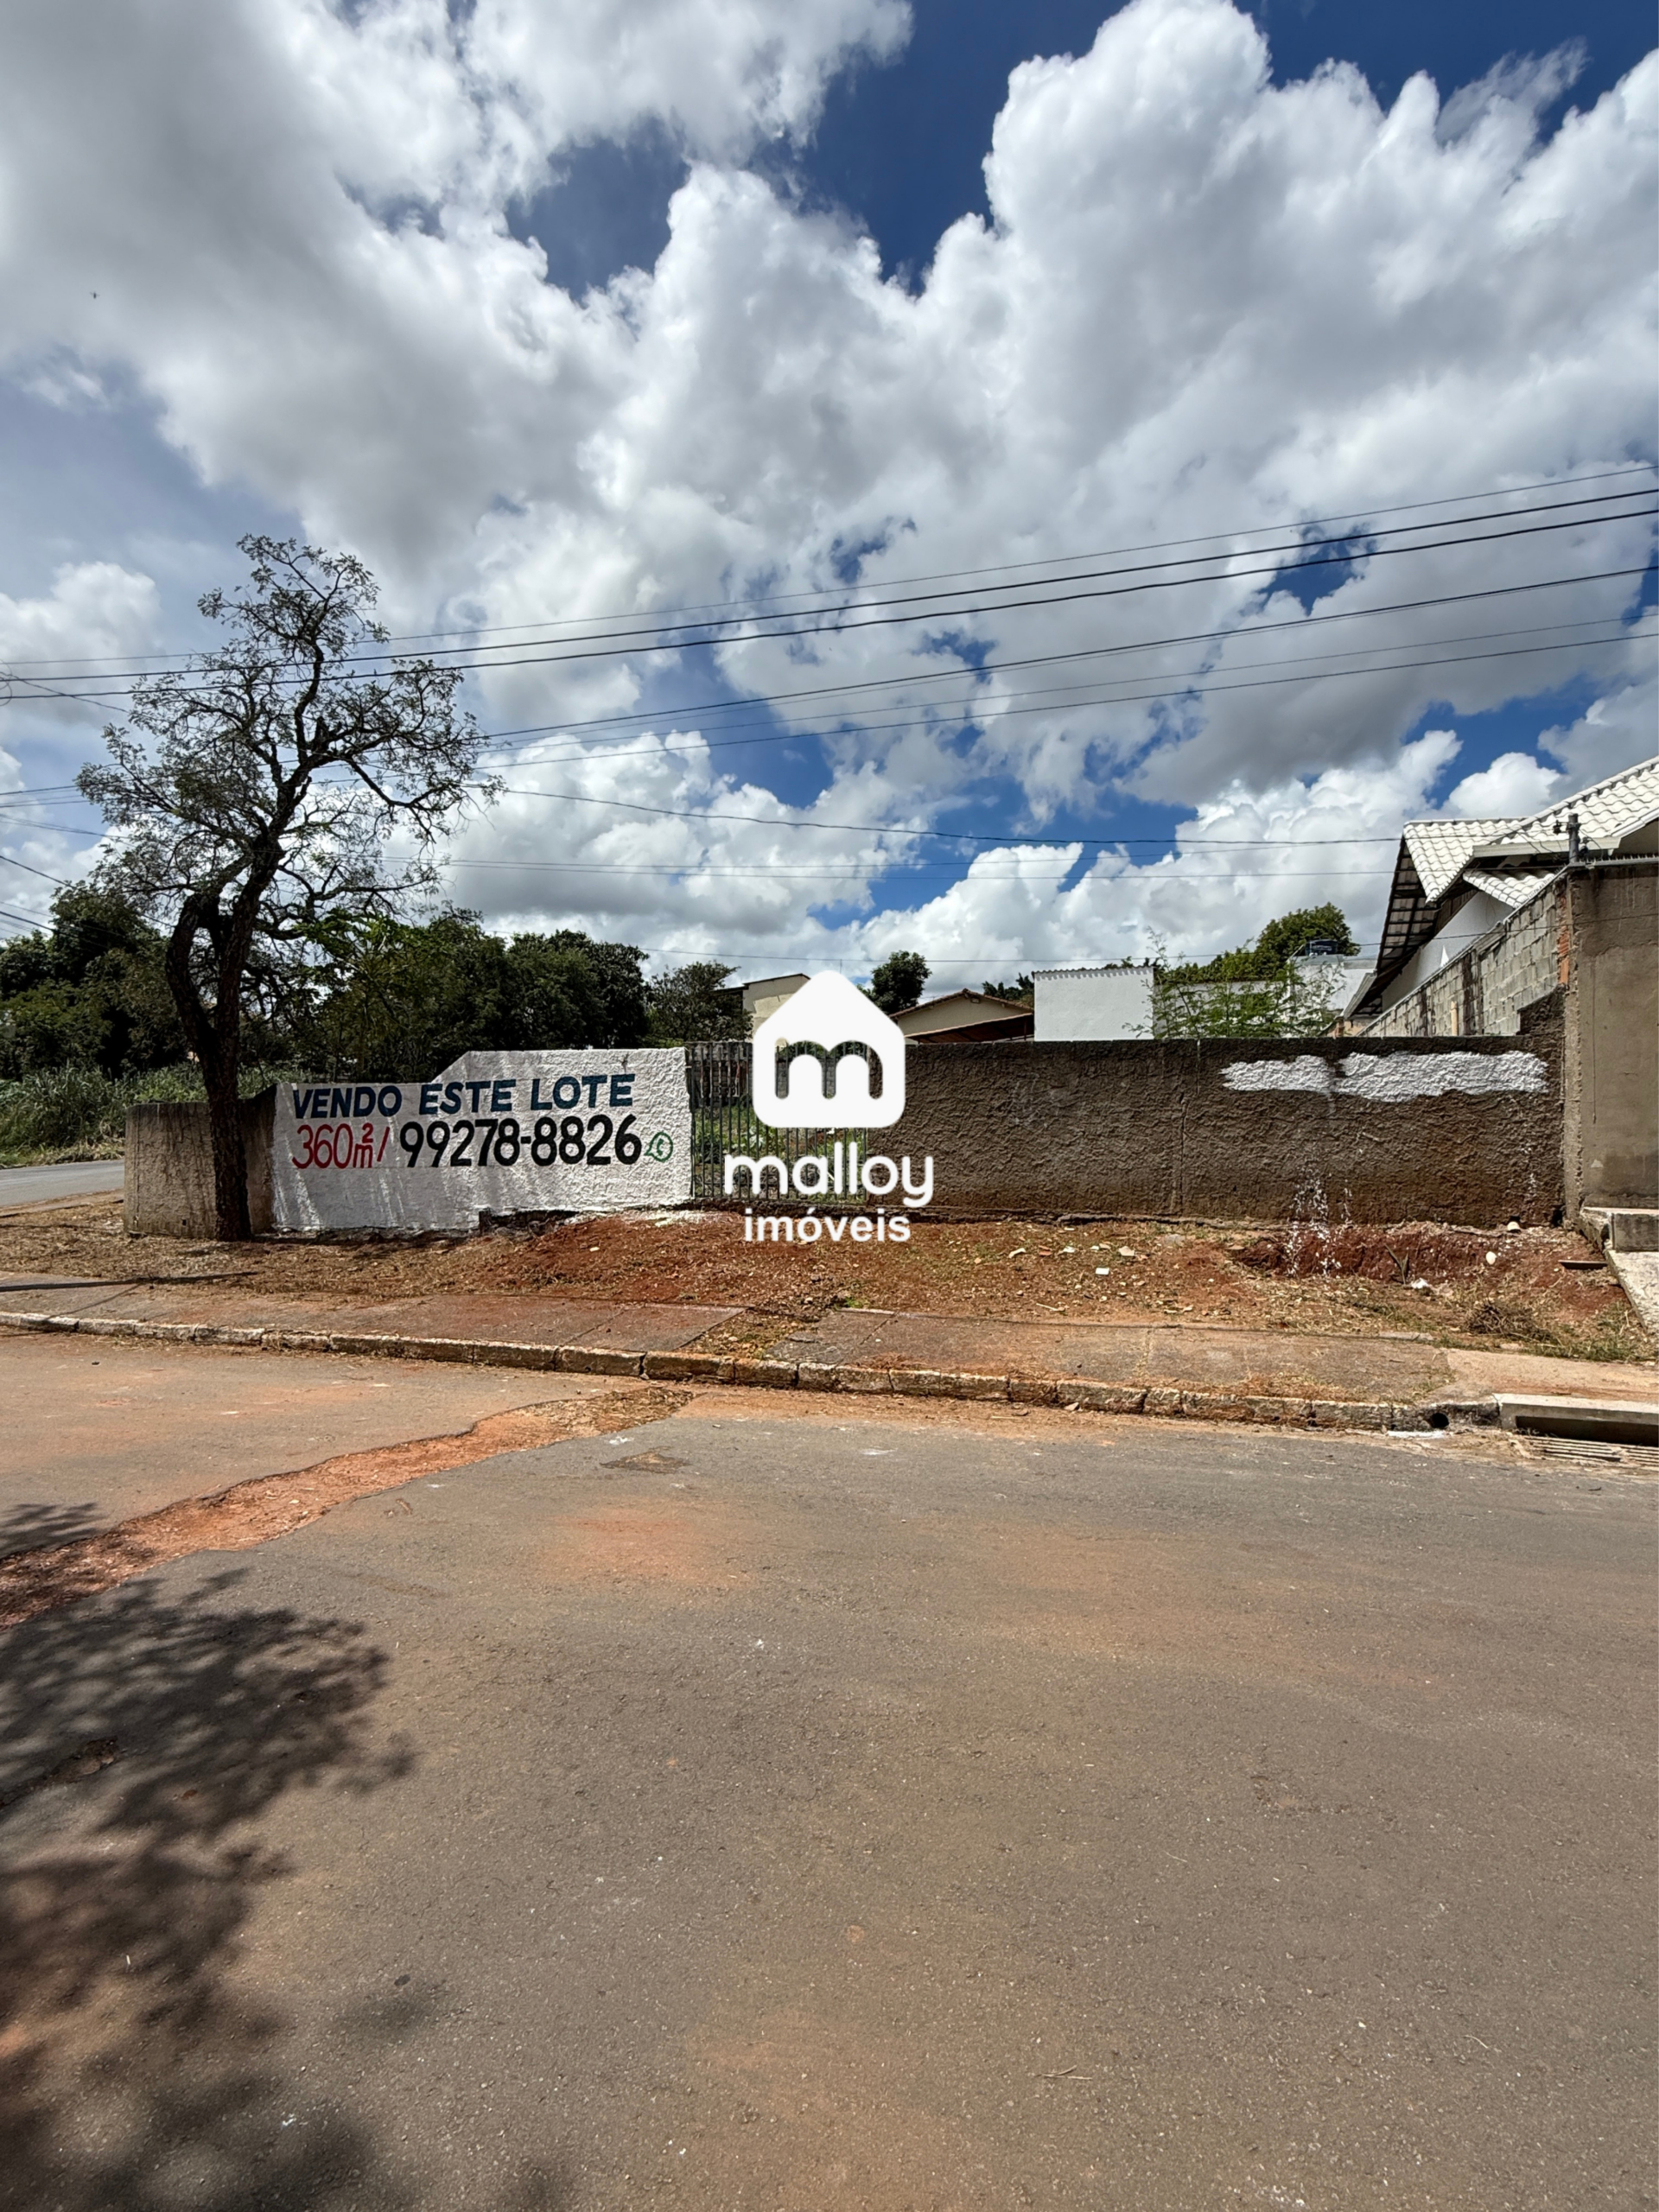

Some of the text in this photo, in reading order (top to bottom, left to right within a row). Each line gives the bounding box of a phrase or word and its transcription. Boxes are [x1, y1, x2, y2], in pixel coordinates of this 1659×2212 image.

[293, 1073, 636, 1119] VENDO ESTE LOTE
[399, 1113, 643, 1168] 99278-8826
